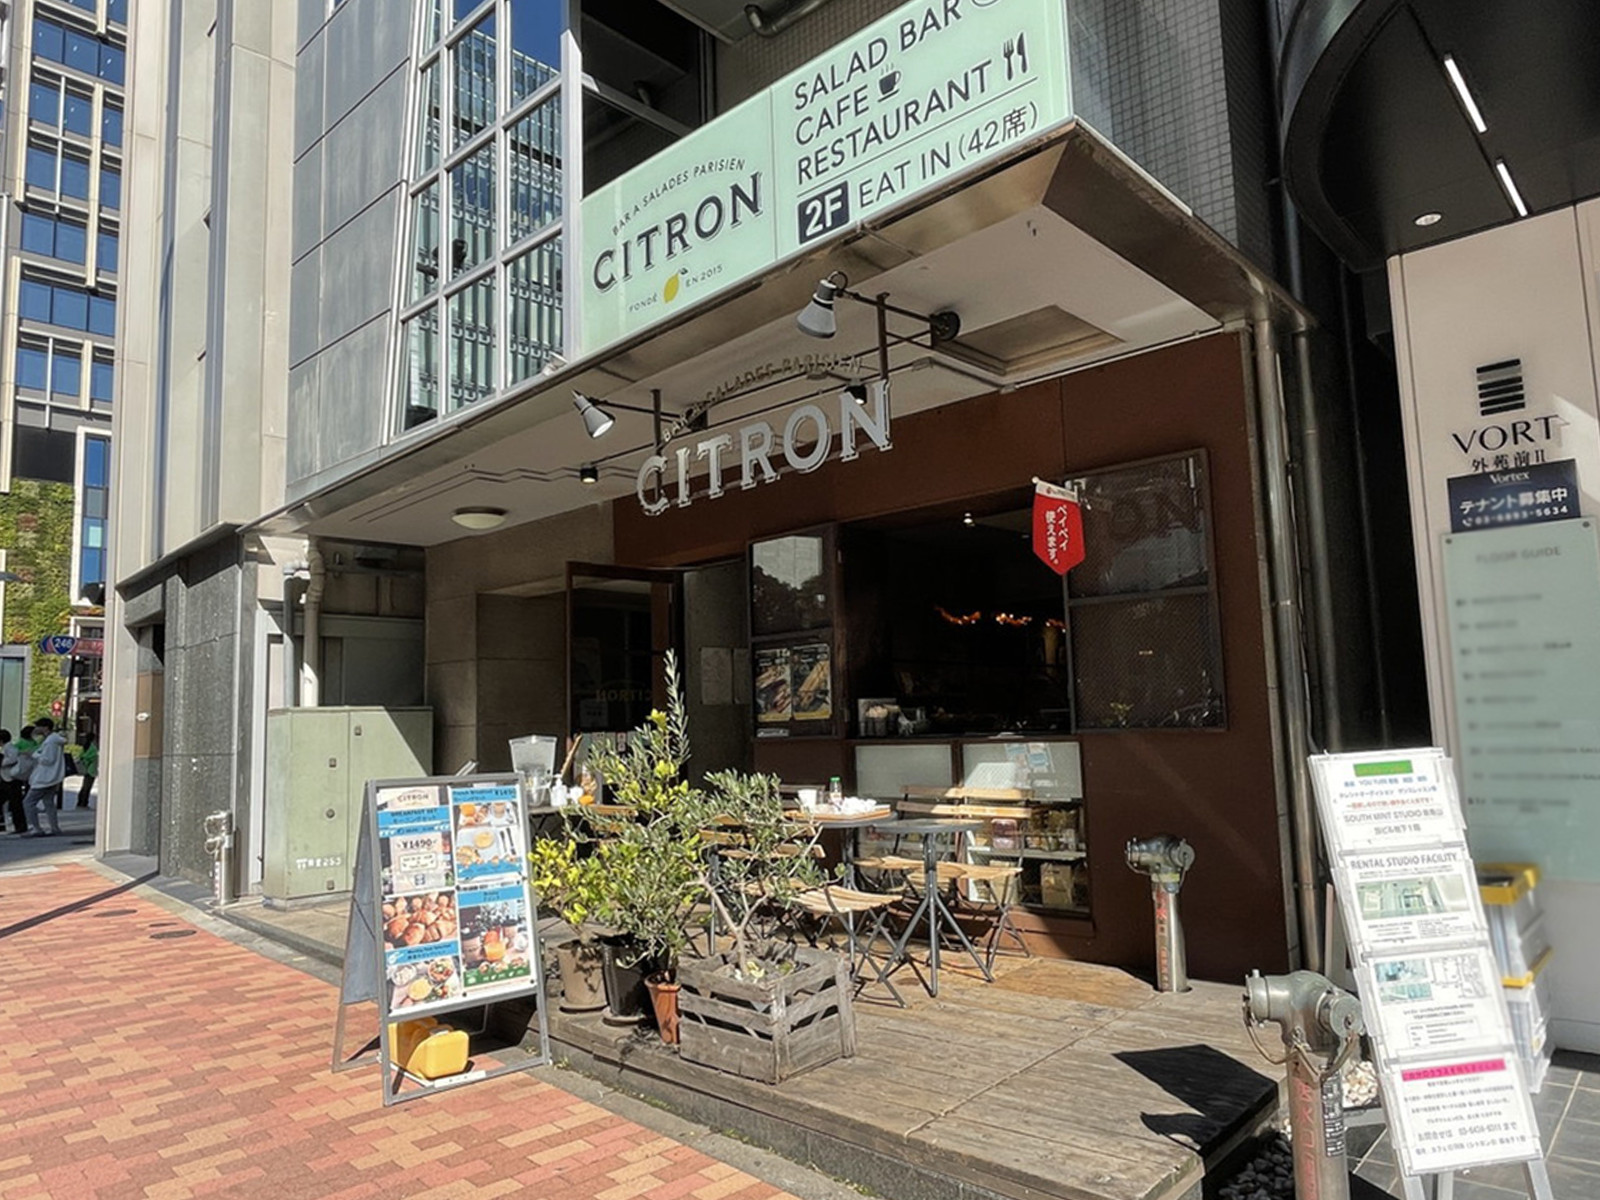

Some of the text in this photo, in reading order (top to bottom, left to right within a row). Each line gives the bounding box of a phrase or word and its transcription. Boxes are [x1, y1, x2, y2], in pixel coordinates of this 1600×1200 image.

[795, 0, 962, 111] SALAD BAR
[796, 84, 870, 146] CAFE
[798, 59, 993, 185] RESTAURANT
[804, 101, 1039, 237] 2F EAT IN (42席)
[612, 212, 630, 236] BAR
[643, 170, 689, 207] SALADES
[693, 157, 745, 177] PARISIEN
[592, 170, 764, 294] CITRON
[685, 276, 699, 288] EN
[700, 264, 723, 282] 2015
[635, 377, 893, 517] CITRON
[1452, 414, 1559, 455] VORT
[1459, 487, 1568, 515] テナント募集中
[1489, 471, 1531, 484] Vortex
[1056, 504, 1069, 552] ペイペイ
[54, 638, 73, 649] 246
[396, 793, 430, 803] CITRON
[1350, 852, 1458, 870] RENTAL STUDIO FACILITY
